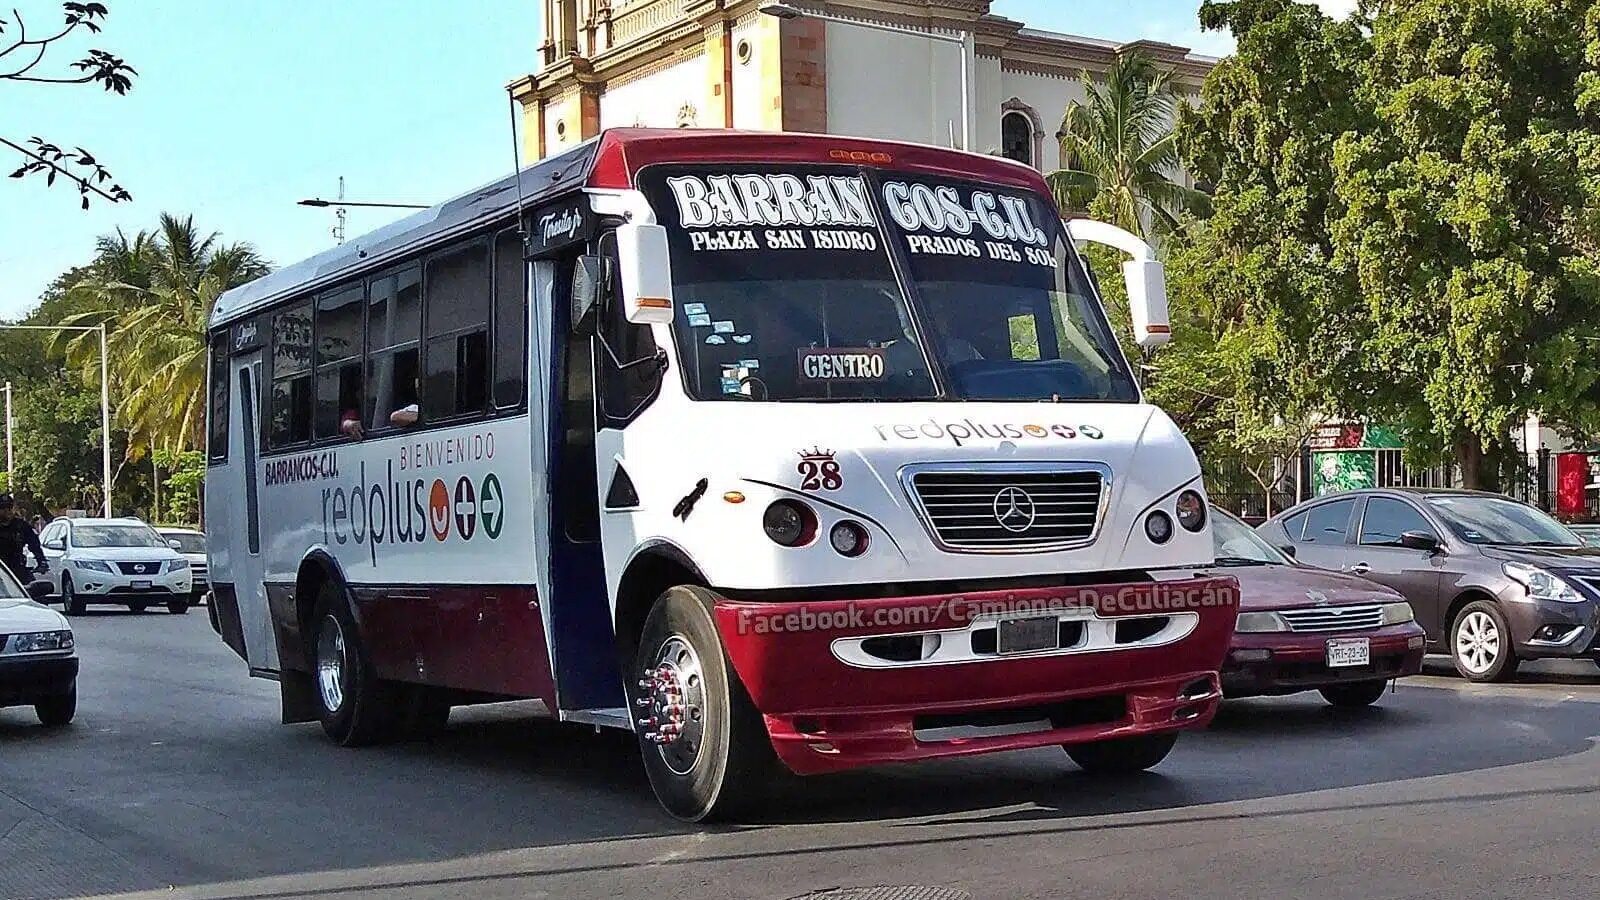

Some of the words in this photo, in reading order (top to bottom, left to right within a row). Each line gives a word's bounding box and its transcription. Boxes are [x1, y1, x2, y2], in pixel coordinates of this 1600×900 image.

[667, 174, 876, 229] BARRAN
[690, 231, 759, 251] PLAZA
[767, 230, 806, 250] SAN
[810, 229, 877, 251] ISIDRO
[906, 235, 981, 258] PRADOS
[986, 243, 1021, 263] DEL
[1025, 247, 1058, 268] SOL
[803, 353, 884, 380] CENTRO
[873, 418, 1023, 447] redplus
[400, 432, 495, 470] BIENVENIDO
[265, 452, 339, 486] BARRANCOS-C.U.
[797, 460, 843, 491] 28
[321, 458, 427, 567] redplus
